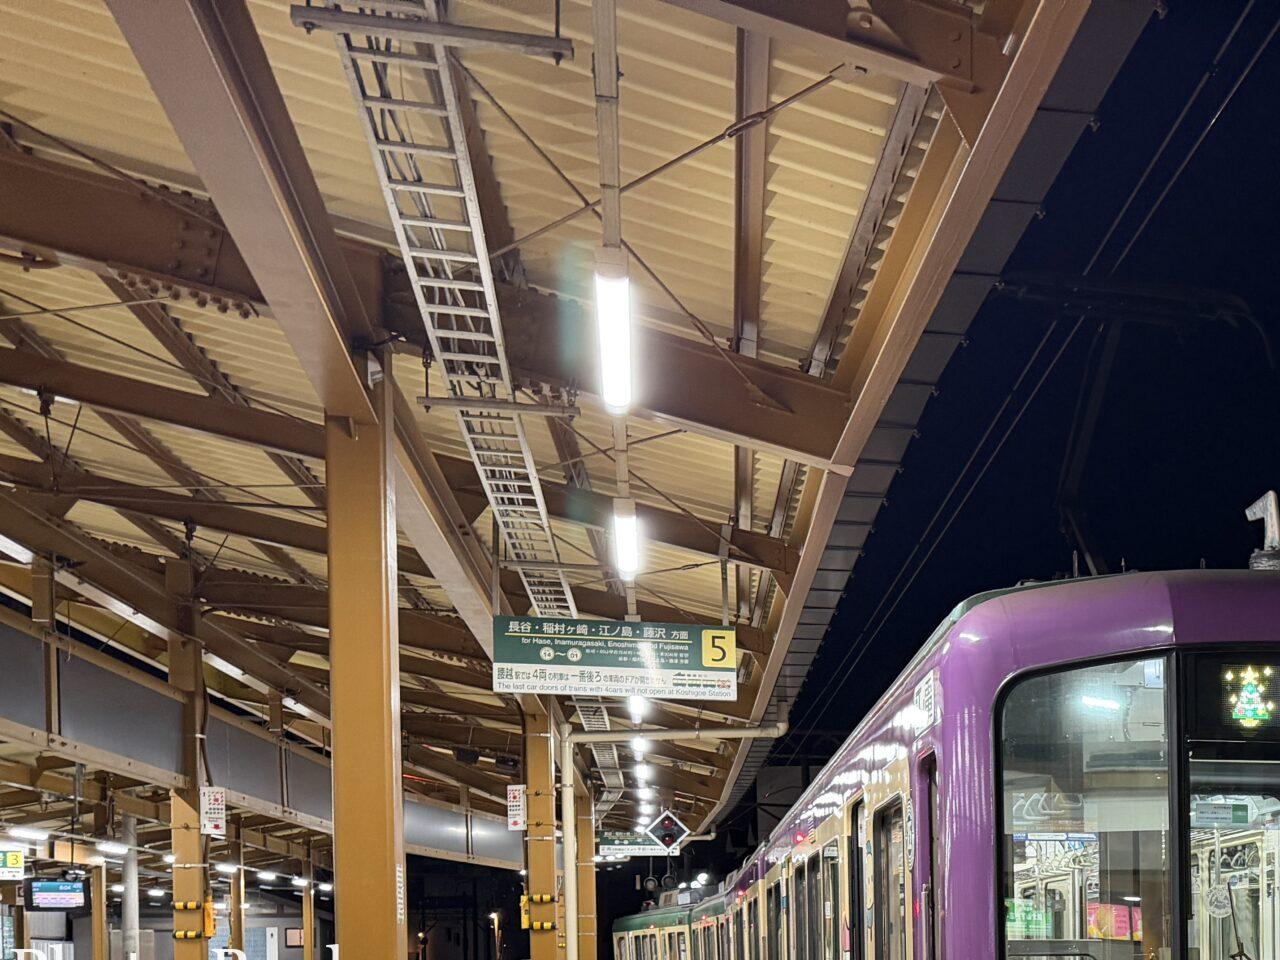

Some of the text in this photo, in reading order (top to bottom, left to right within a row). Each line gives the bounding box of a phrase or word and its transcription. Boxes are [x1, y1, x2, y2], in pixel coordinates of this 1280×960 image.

[671, 630, 689, 639] 方面
[659, 643, 689, 652] Fujisawa
[711, 635, 727, 662] 5
[11, 854, 19, 865] 3
